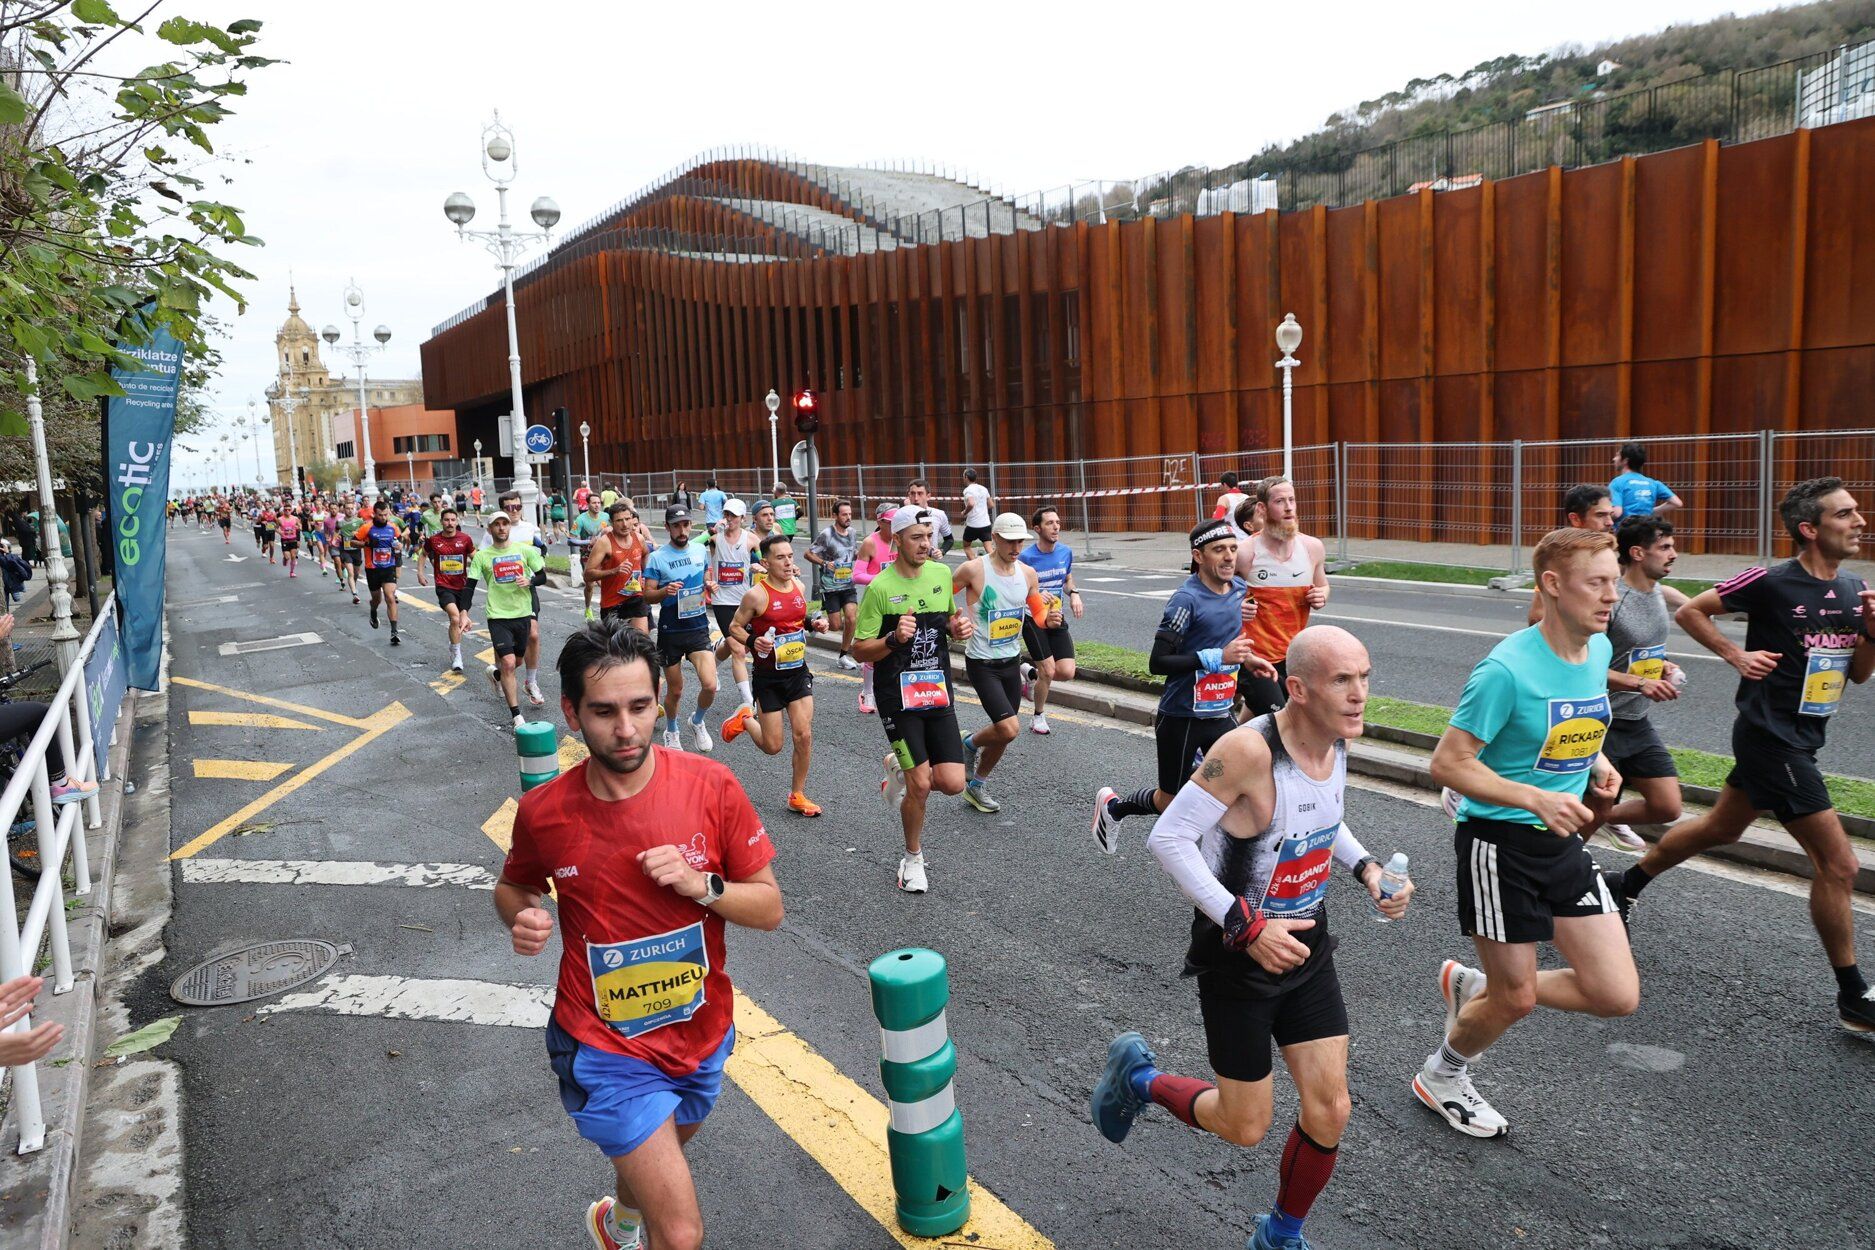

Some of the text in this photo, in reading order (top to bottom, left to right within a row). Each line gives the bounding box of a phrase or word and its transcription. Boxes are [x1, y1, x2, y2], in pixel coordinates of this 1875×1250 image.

[125, 398, 174, 410] Recycling area
[118, 441, 155, 566] ecotic
[999, 622, 1019, 631] MARIO
[1576, 703, 1605, 715] ZURICH
[1559, 729, 1605, 745] RICKARD
[1298, 802, 1317, 813] GOBIK
[554, 865, 580, 879] HOKA
[630, 938, 687, 961] ZURICH
[608, 966, 704, 1001] MATTHIEU
[642, 998, 672, 1015] 709
